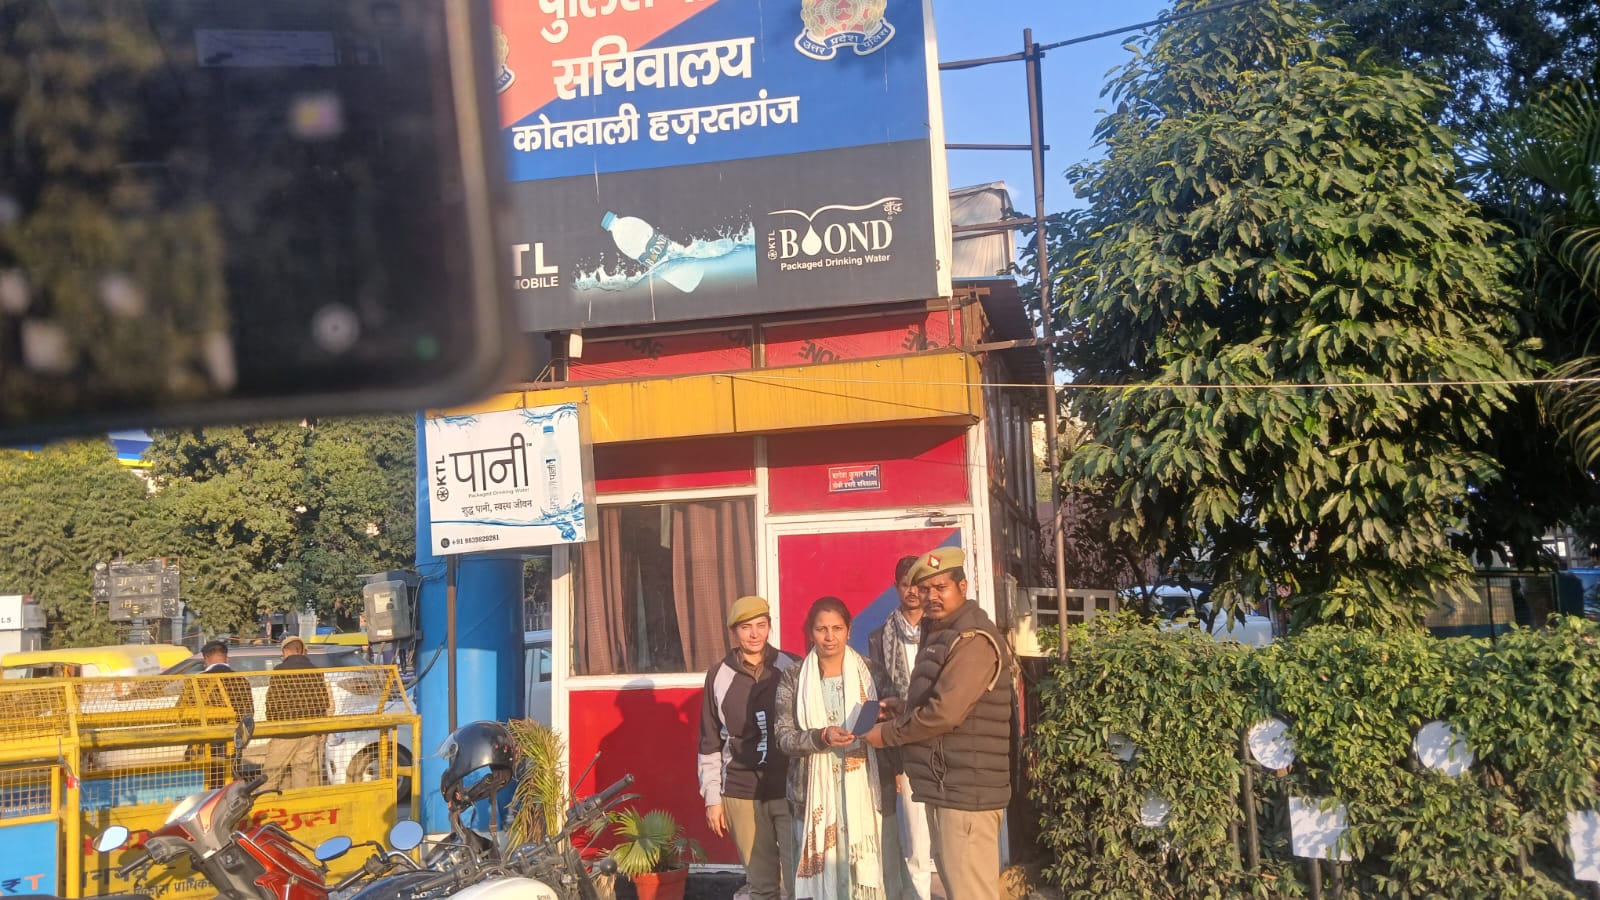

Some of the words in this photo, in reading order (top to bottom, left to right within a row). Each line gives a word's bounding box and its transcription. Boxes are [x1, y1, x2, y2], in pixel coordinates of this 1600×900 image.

[552, 35, 756, 100] सचिवालय
[512, 102, 640, 152] कोतवाली
[648, 89, 801, 145] हज़रतगंज
[780, 257, 823, 271] Packaged
[825, 255, 863, 268] Drinking
[865, 253, 891, 264] Water
[514, 275, 560, 290] OBILE
[435, 455, 447, 486] KTL
[449, 432, 529, 492] पानी
[512, 499, 532, 508] जीवन
